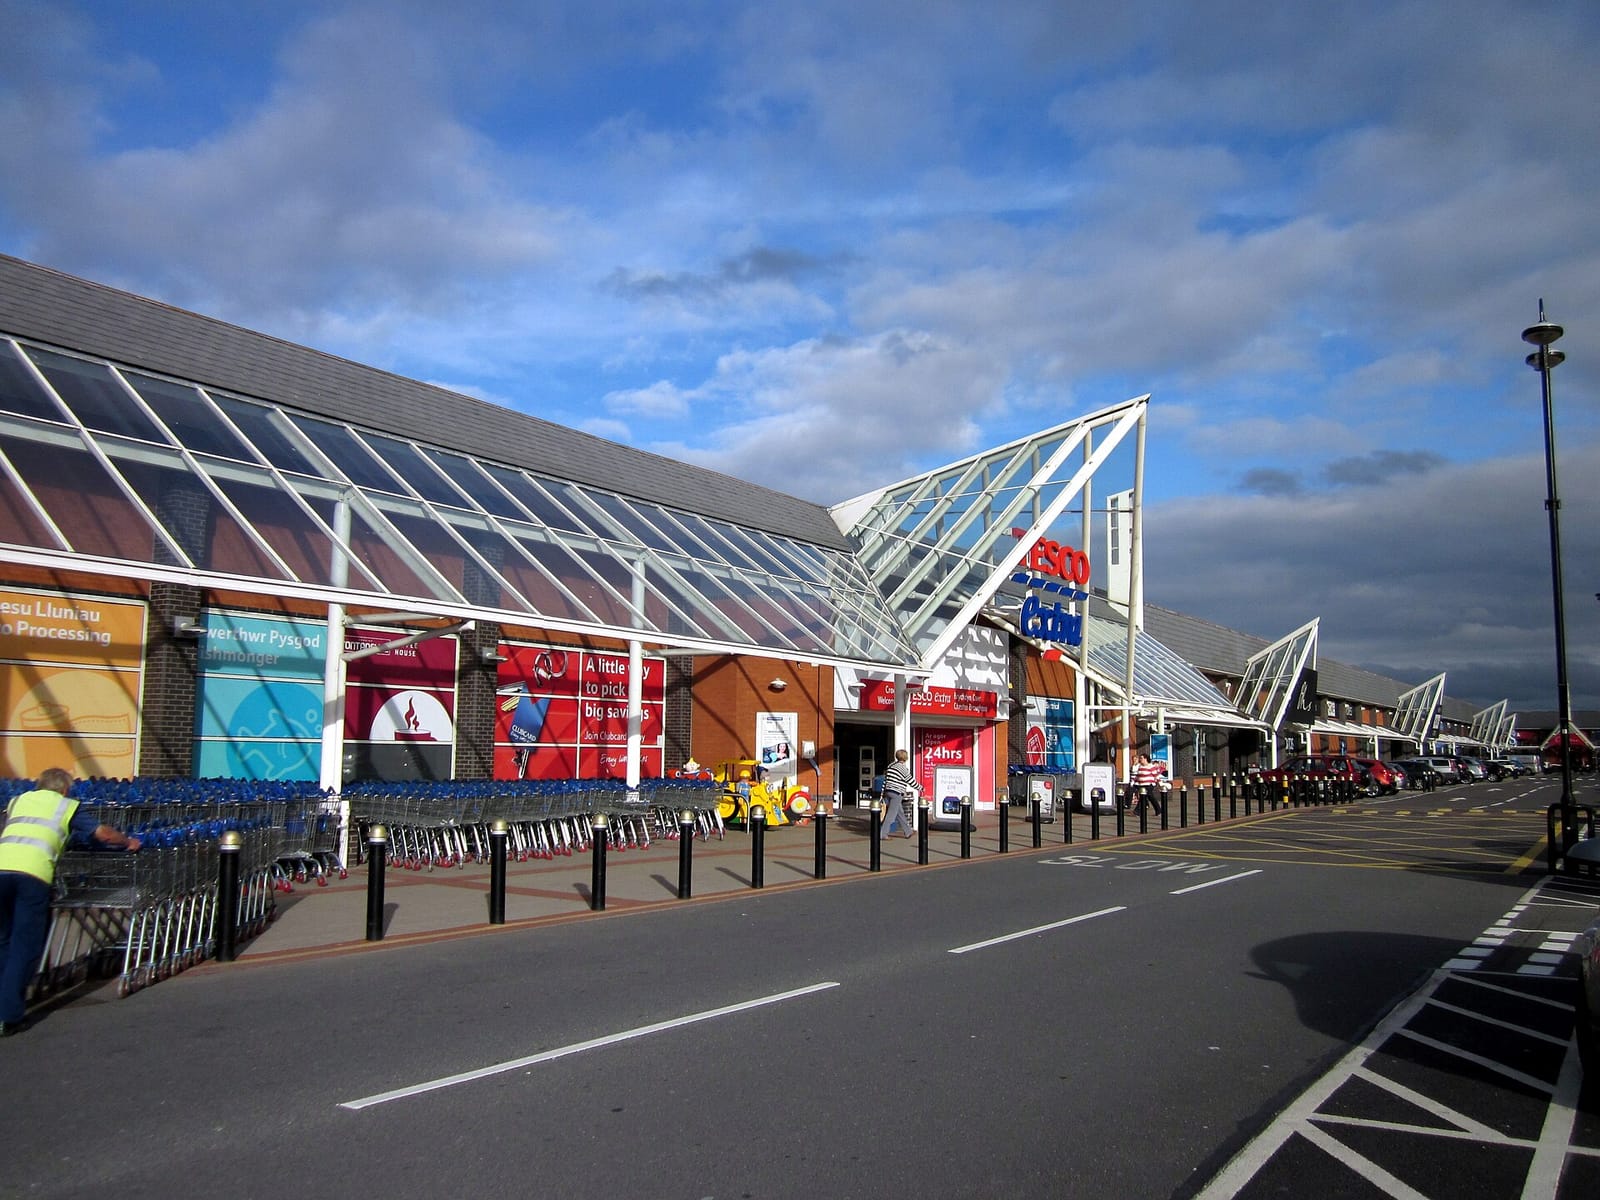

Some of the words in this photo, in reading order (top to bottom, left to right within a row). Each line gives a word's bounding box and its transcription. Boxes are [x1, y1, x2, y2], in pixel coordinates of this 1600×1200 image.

[36, 601, 100, 622] Lluniau
[16, 620, 111, 647] Processing
[270, 630, 320, 649] Pysgod
[394, 649, 417, 657] HOUSE
[586, 657, 595, 672] A
[598, 658, 625, 674] little
[585, 681, 598, 694] to
[601, 681, 626, 697] pick
[585, 702, 604, 720] big
[607, 705, 649, 722] savis
[511, 724, 537, 742] CLUBCARD
[584, 731, 598, 740] Join
[599, 731, 627, 741] Clubcard
[600, 753, 617, 767] Every
[924, 746, 963, 760] 24hrs
[1036, 855, 1230, 874] SLOW
